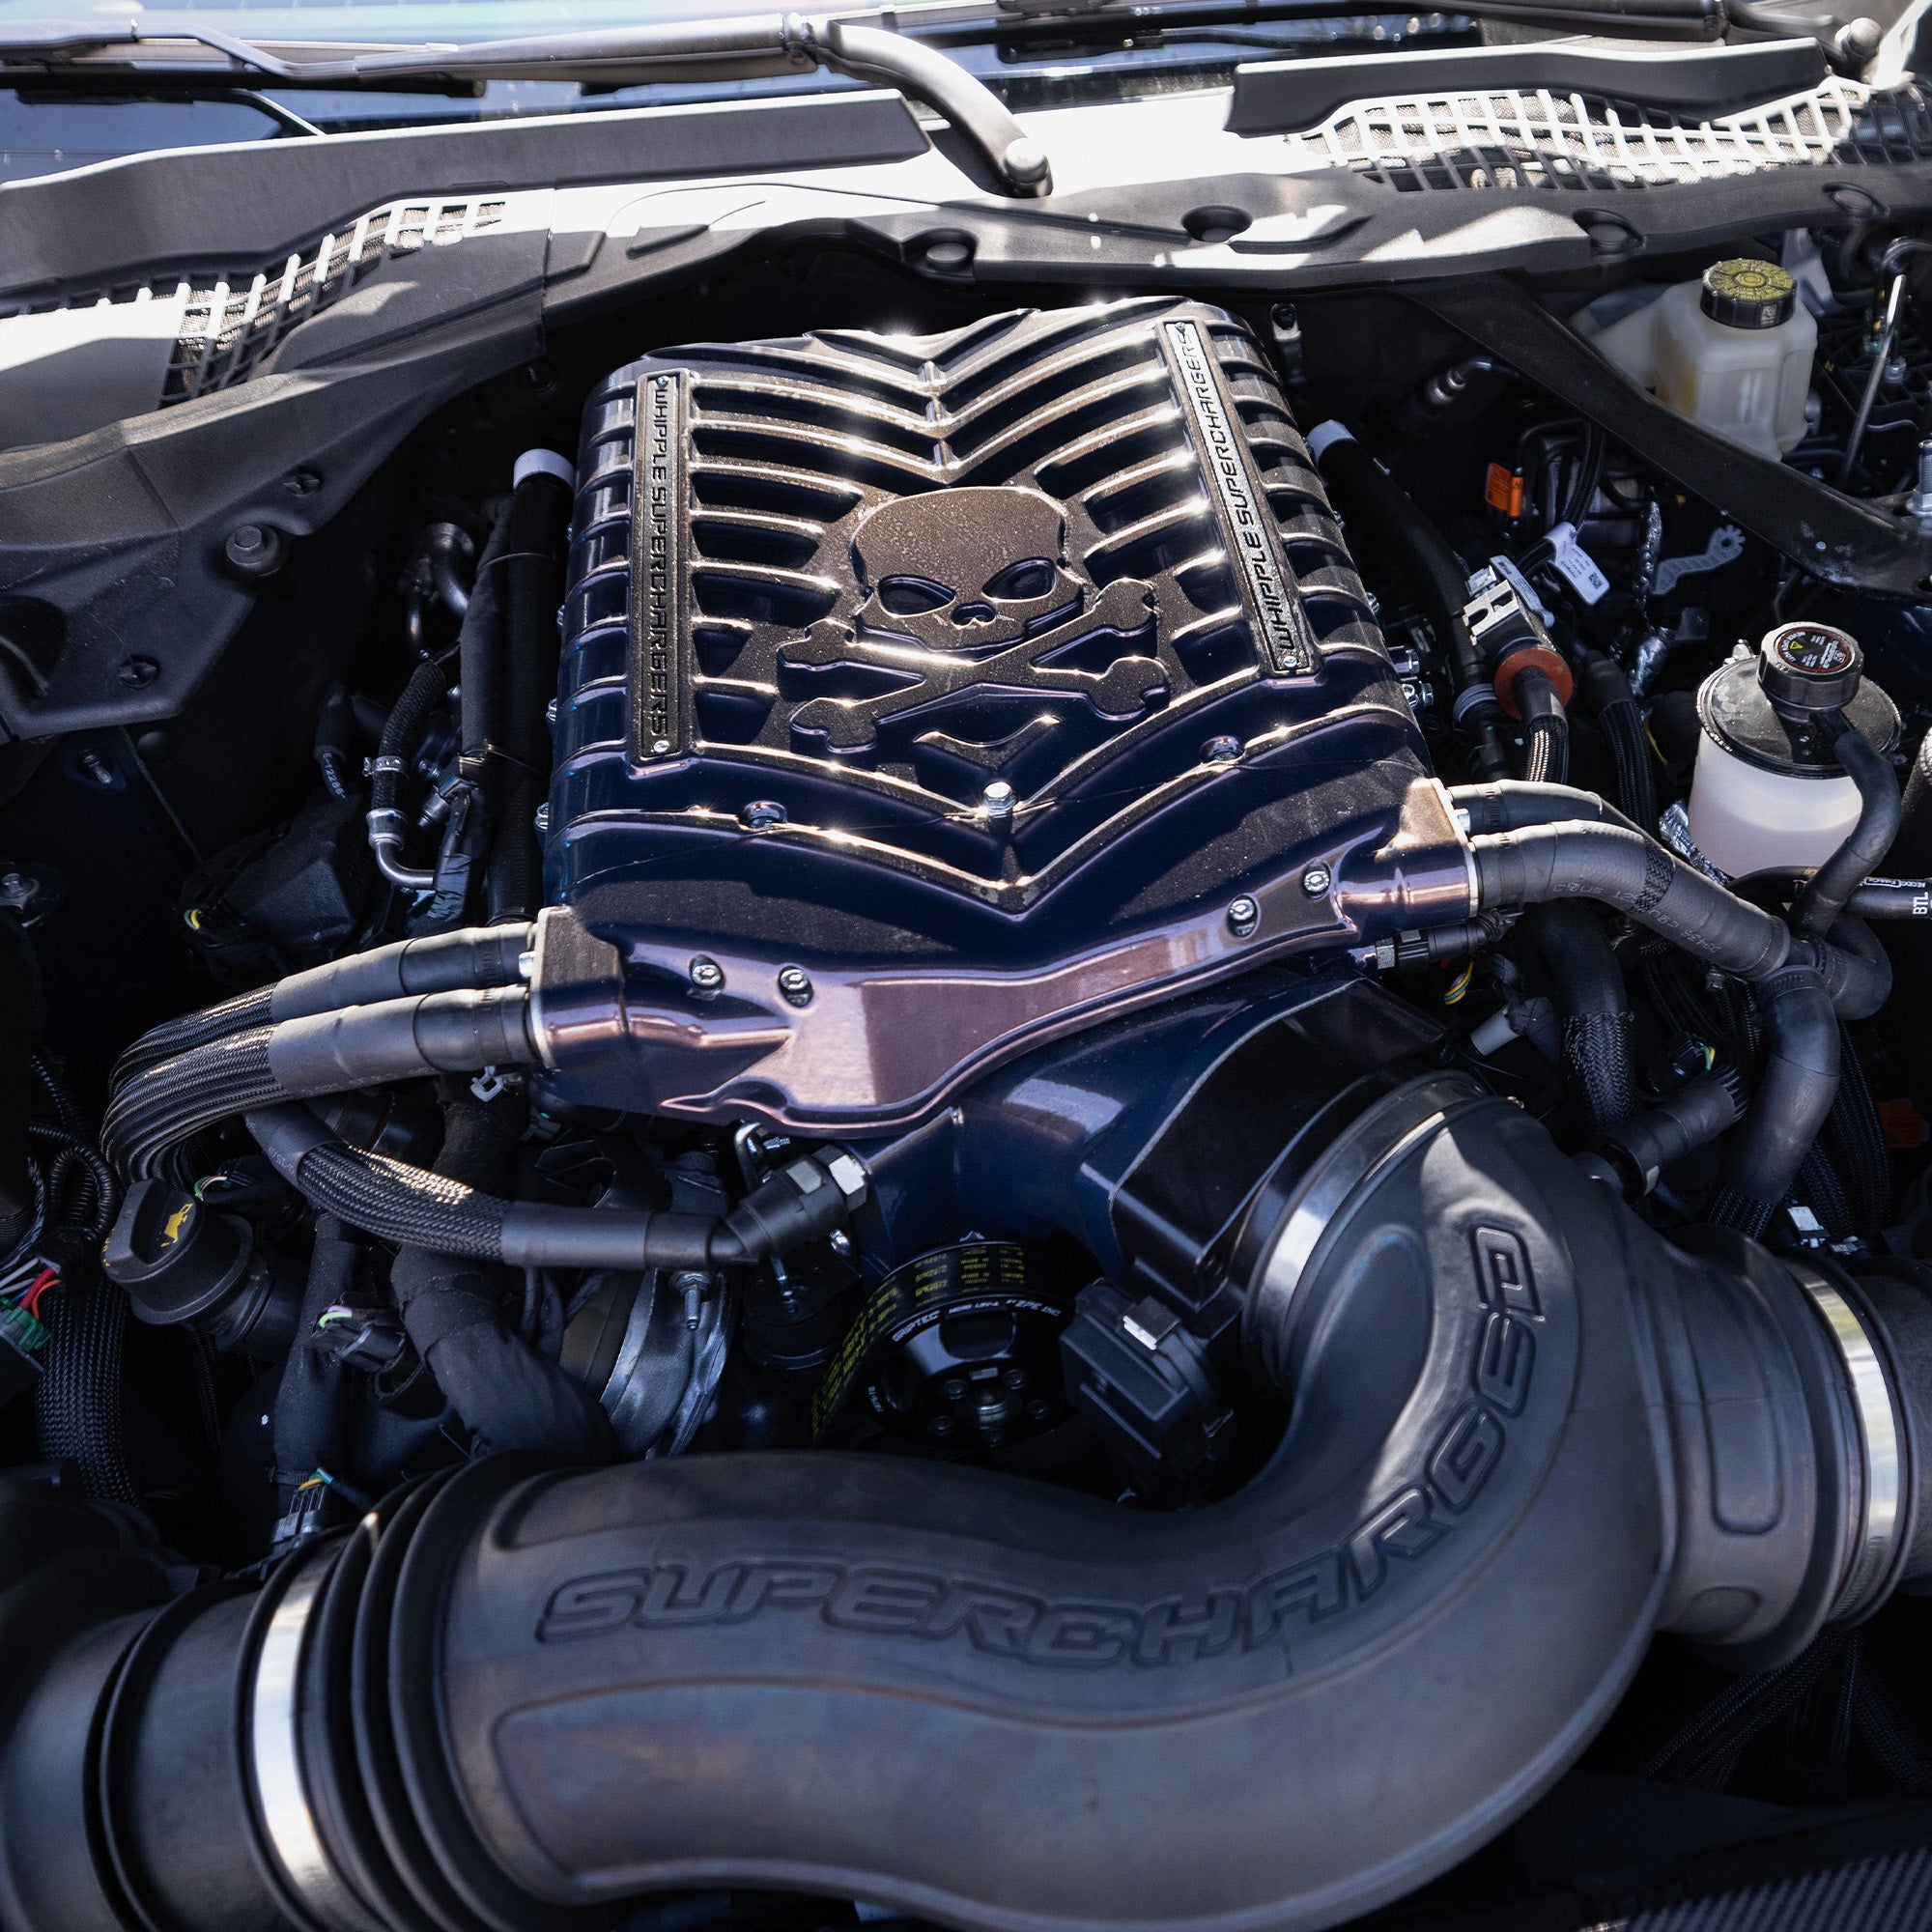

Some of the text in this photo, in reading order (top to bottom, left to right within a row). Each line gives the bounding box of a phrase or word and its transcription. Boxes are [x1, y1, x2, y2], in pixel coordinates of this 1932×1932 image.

[649, 388, 669, 737] WHIPPLE SUPERCHARGERS
[1179, 333, 1294, 651] WHIPPLE SUPERCHARGERS
[1913, 891, 1928, 915] BTL
[892, 1309, 941, 1343] GRIPTEC
[1040, 1304, 1062, 1318] INC
[535, 1223, 1546, 1669] SUPERCHARGED
